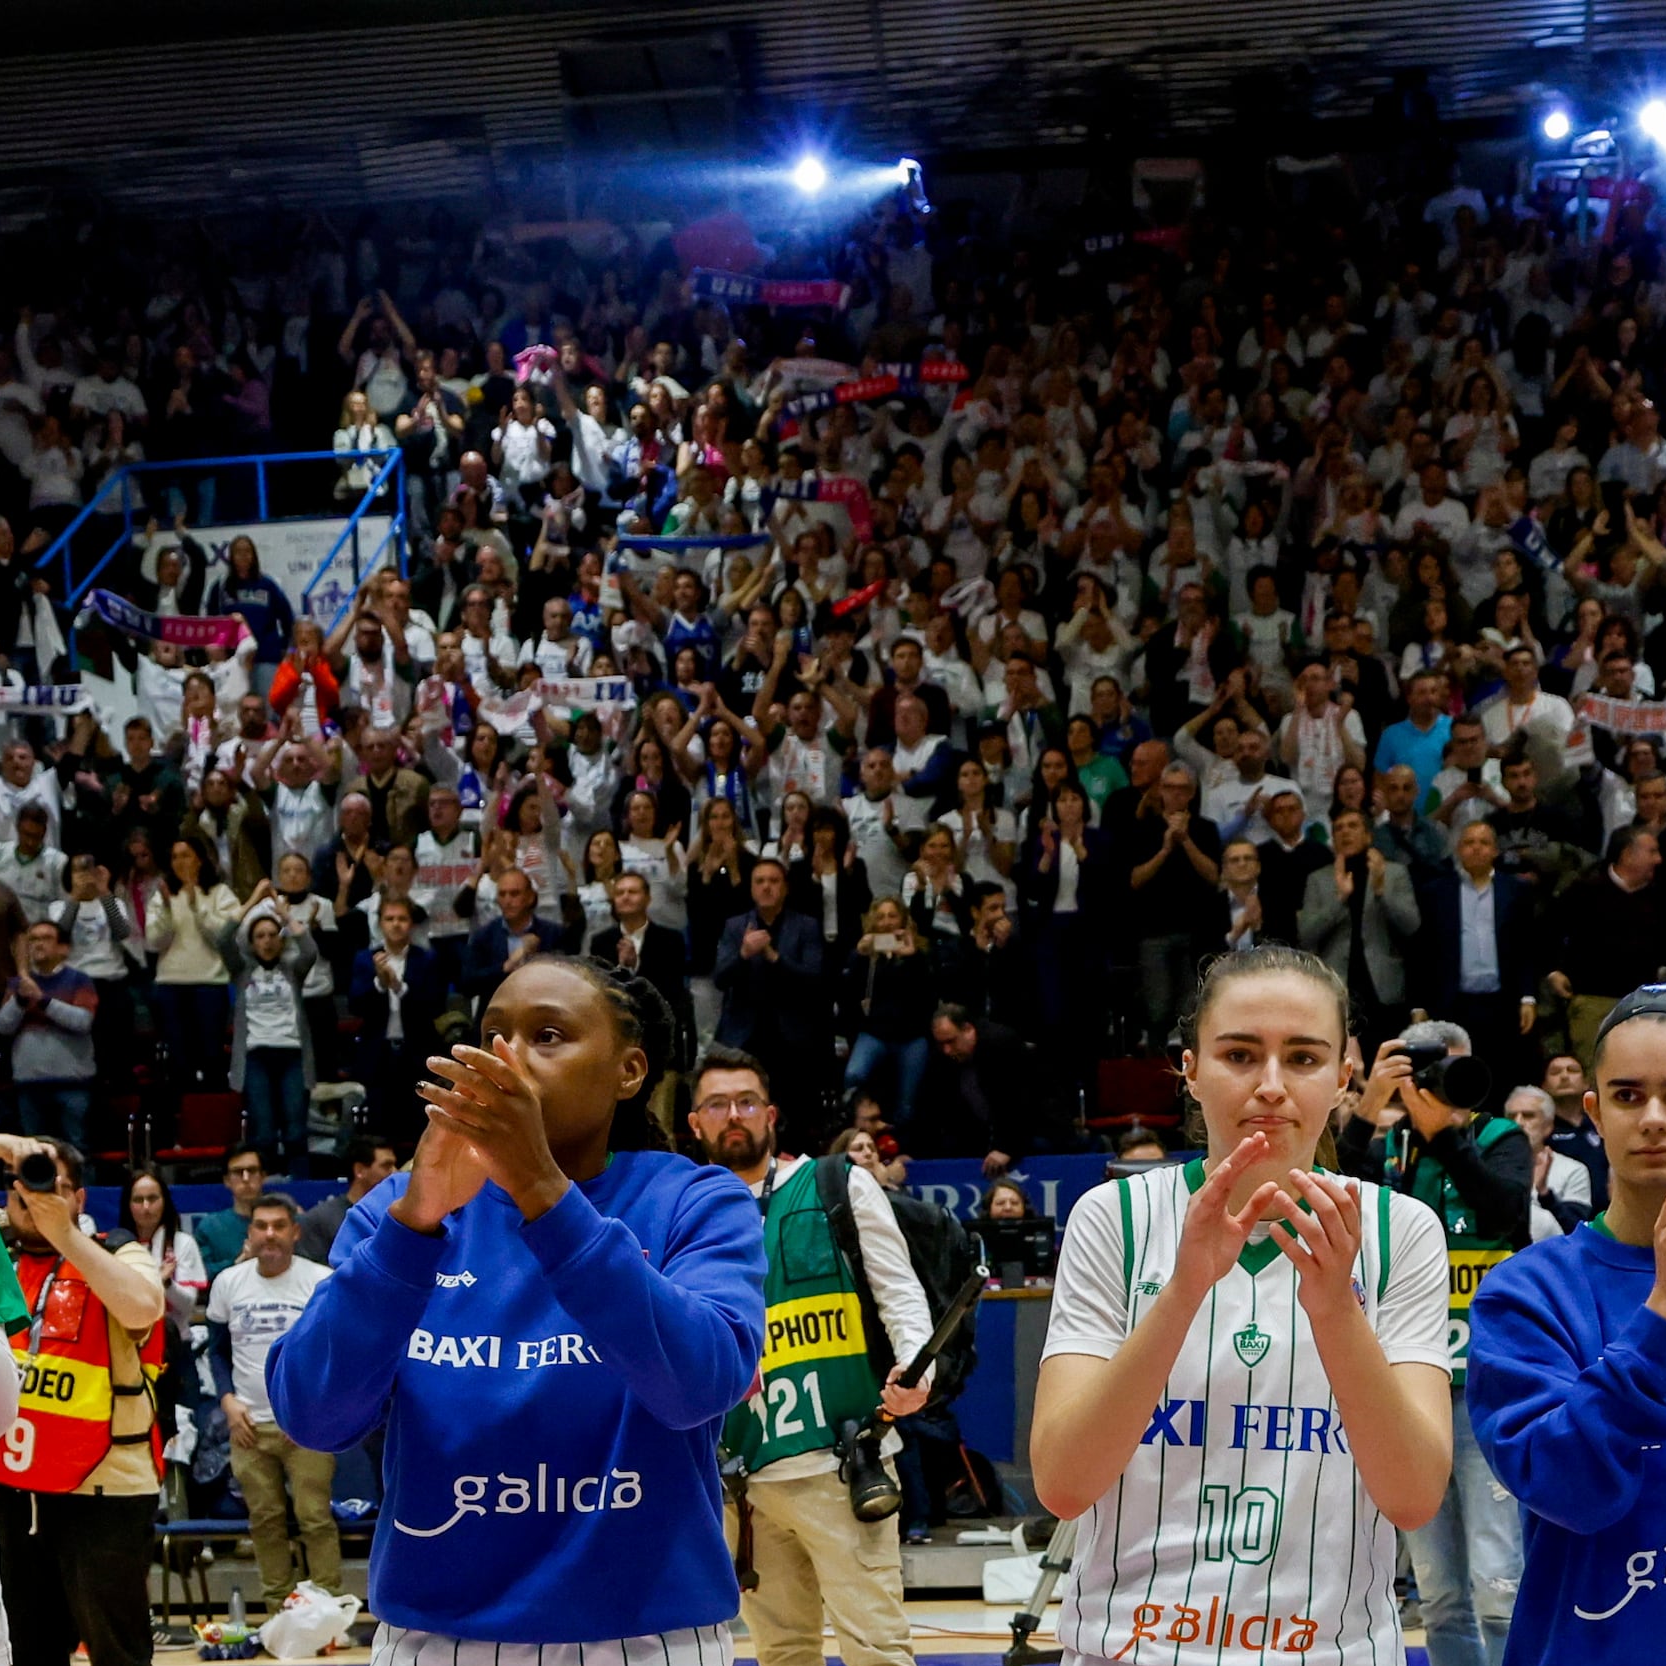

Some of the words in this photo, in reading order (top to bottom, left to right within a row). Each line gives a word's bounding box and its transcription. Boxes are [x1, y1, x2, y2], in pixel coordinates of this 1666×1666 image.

[407, 1328, 501, 1369] BAXI
[1240, 1340, 1265, 1350] BAXI
[19, 1366, 75, 1402] DEO
[1141, 1399, 1205, 1449] XI
[393, 1463, 643, 1538] galicia
[1203, 1484, 1280, 1566] 10
[1113, 1596, 1320, 1661] galicia
